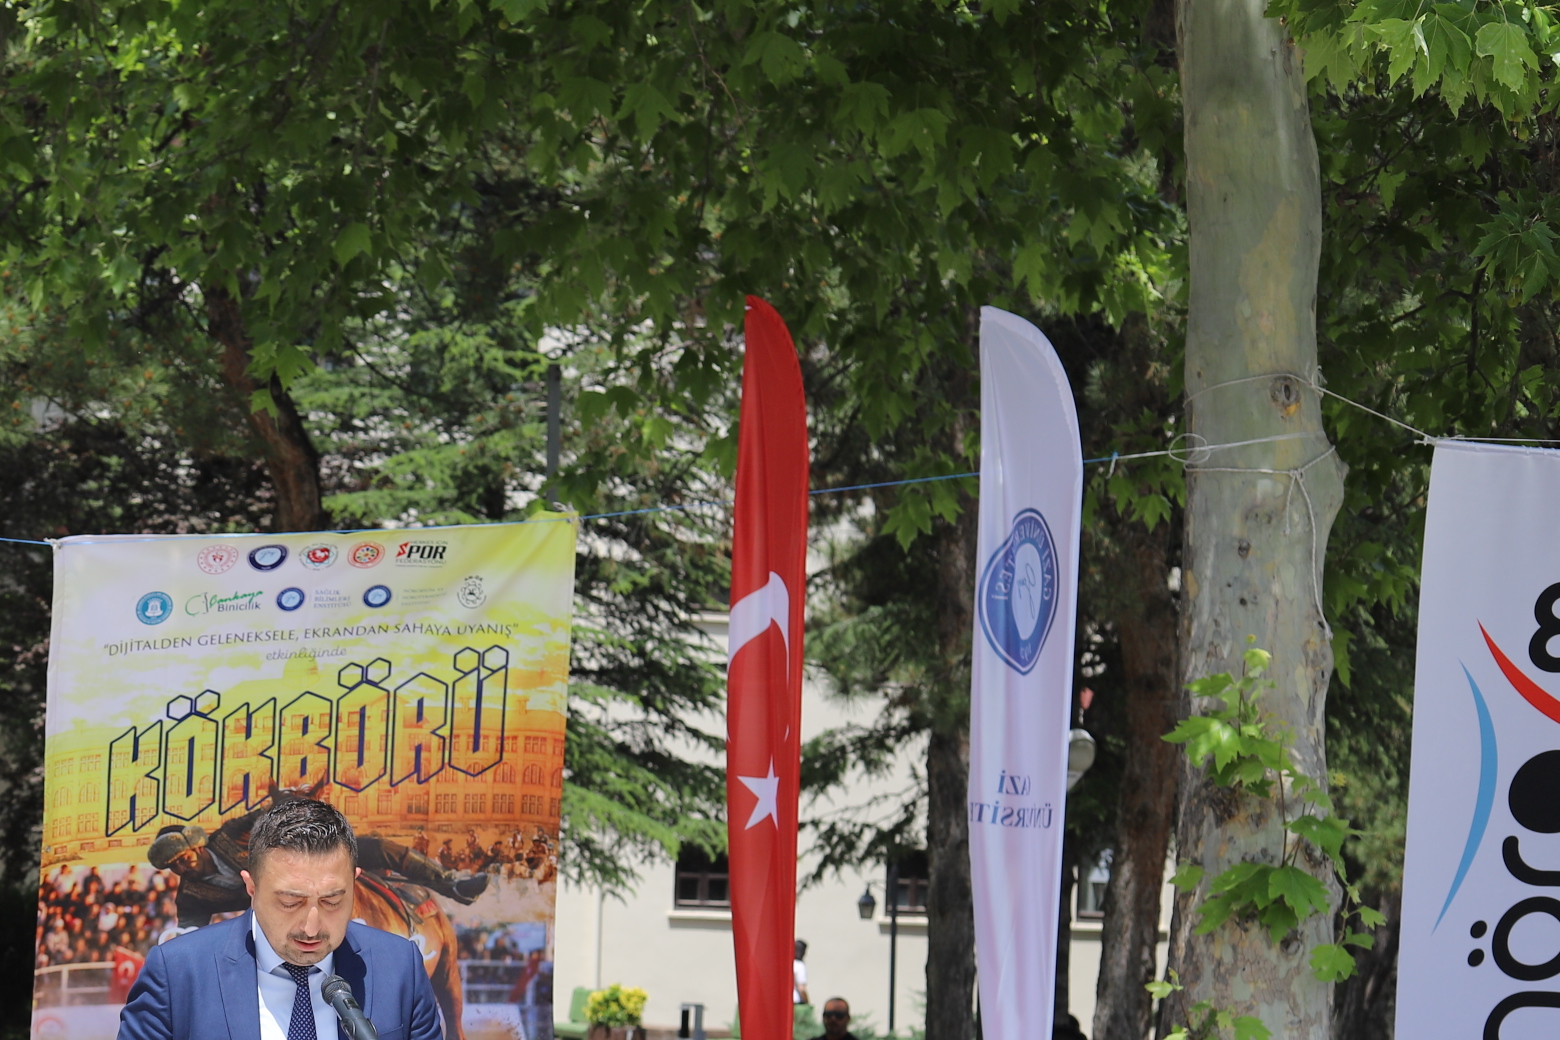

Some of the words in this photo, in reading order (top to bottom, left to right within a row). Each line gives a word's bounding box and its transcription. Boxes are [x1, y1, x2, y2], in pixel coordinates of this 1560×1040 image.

[395, 541, 447, 560] SPOR
[217, 601, 261, 612] Binicilik
[197, 628, 301, 647] GELENEKSELE,
[303, 623, 390, 639] EKRANDAN
[393, 622, 452, 636] SAHAYA
[265, 645, 347, 662] etkinliğinde
[106, 644, 510, 838] KÖKBÖRÜ
